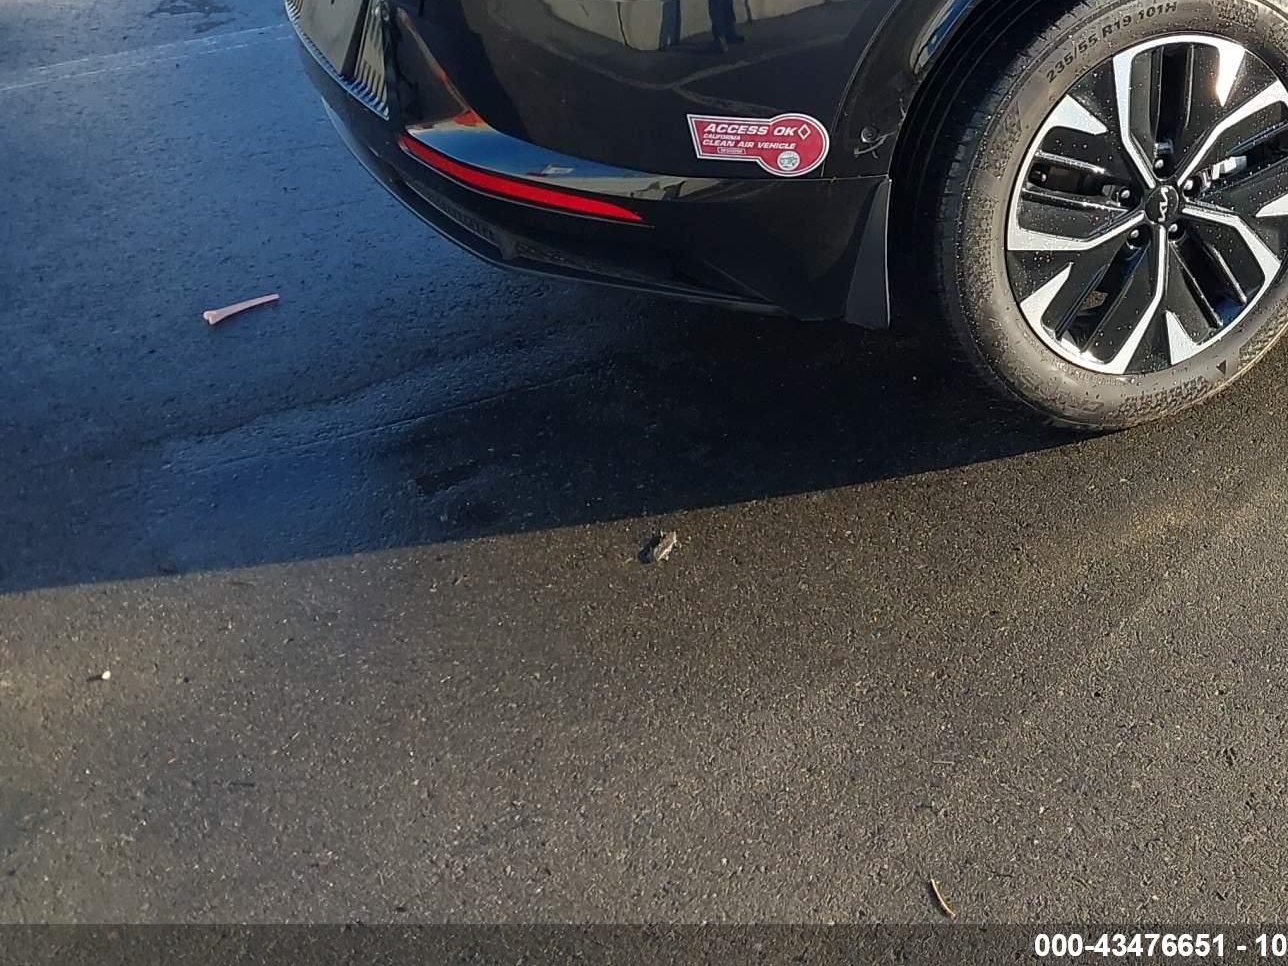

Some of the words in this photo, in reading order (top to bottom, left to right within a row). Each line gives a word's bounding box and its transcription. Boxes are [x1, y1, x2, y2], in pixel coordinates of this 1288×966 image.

[1046, 33, 1098, 83] 235/55
[1102, 15, 1132, 37] R19
[1137, 1, 1178, 20] 101H
[704, 123, 769, 135] ACCESS
[773, 126, 798, 136] OK
[702, 139, 736, 147] CLEAN
[757, 141, 797, 150] VEHICLE
